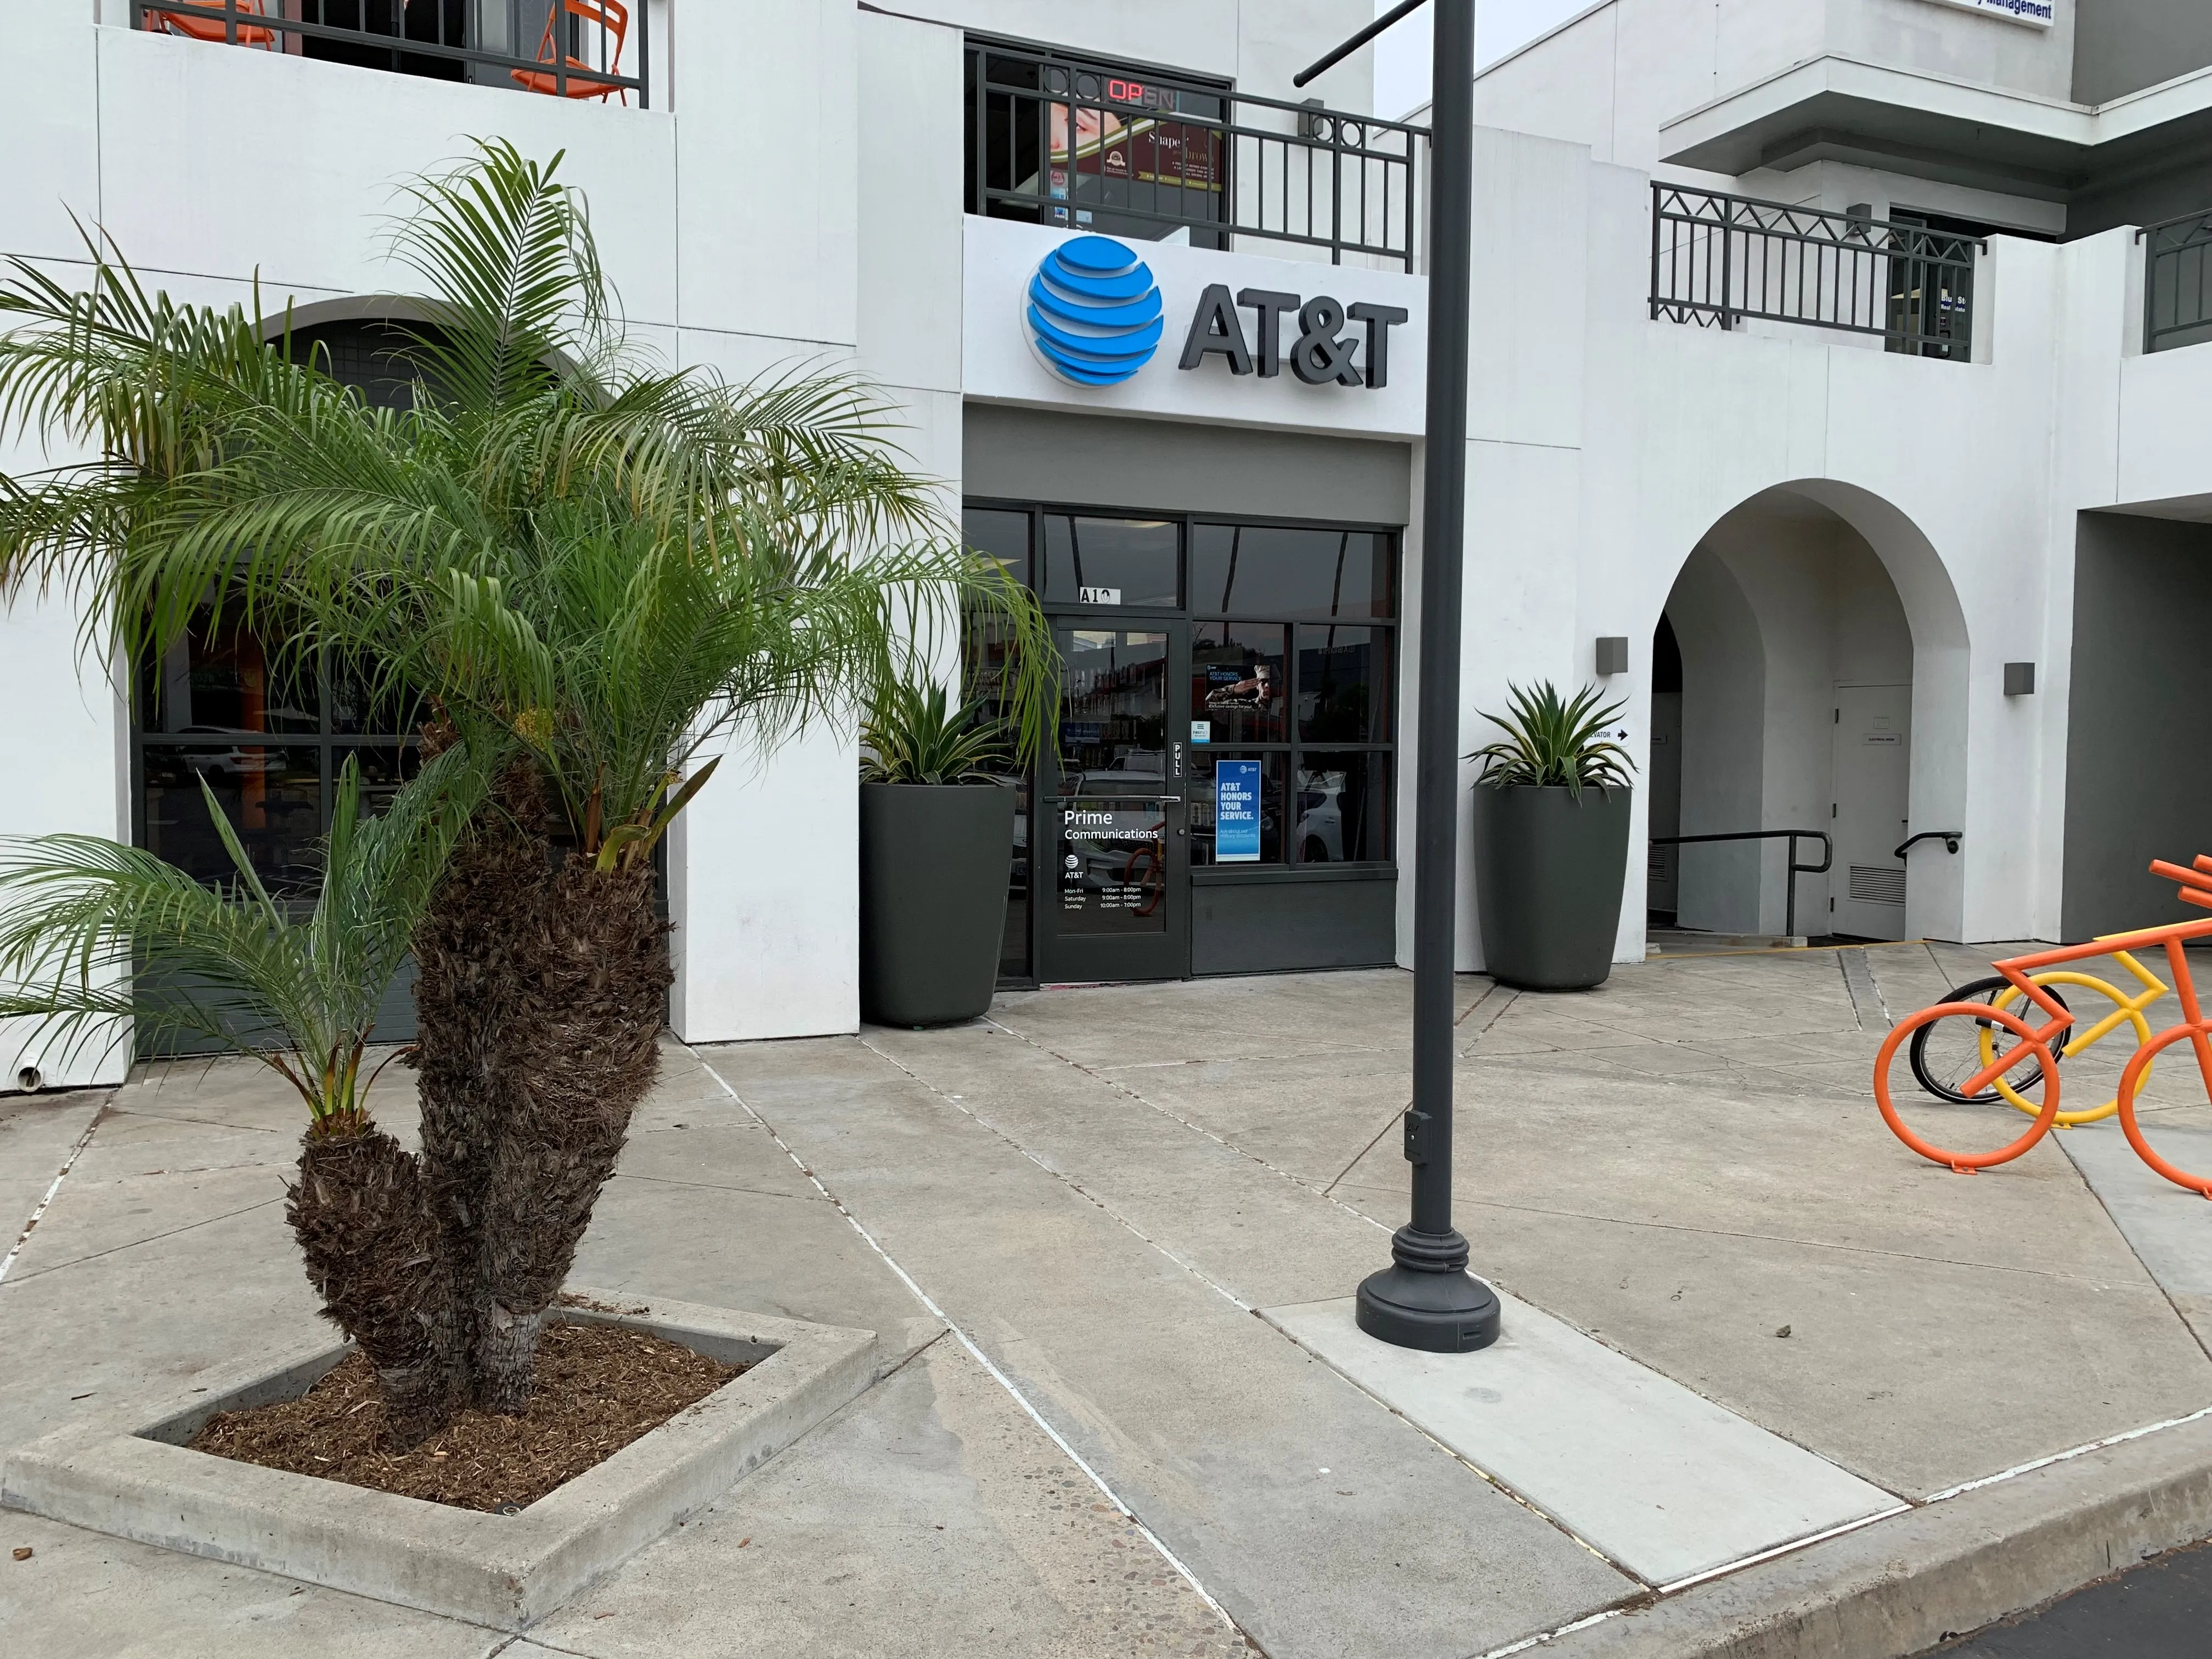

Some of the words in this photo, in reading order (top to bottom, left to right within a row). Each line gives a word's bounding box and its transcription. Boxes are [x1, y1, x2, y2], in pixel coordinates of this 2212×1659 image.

[1987, 0, 2051, 19] anagement
[1109, 80, 1173, 109] OPEN
[1186, 146, 1214, 163] brow
[1178, 284, 1408, 389] AT&T
[1081, 588, 1110, 603] A10
[1221, 782, 1241, 791] AT&T
[1221, 792, 1252, 801] HONORS
[1221, 802, 1242, 810] YOUR
[1064, 810, 1113, 825] Prime
[1220, 811, 1254, 820] SERVICE.
[1064, 828, 1158, 840] Communications
